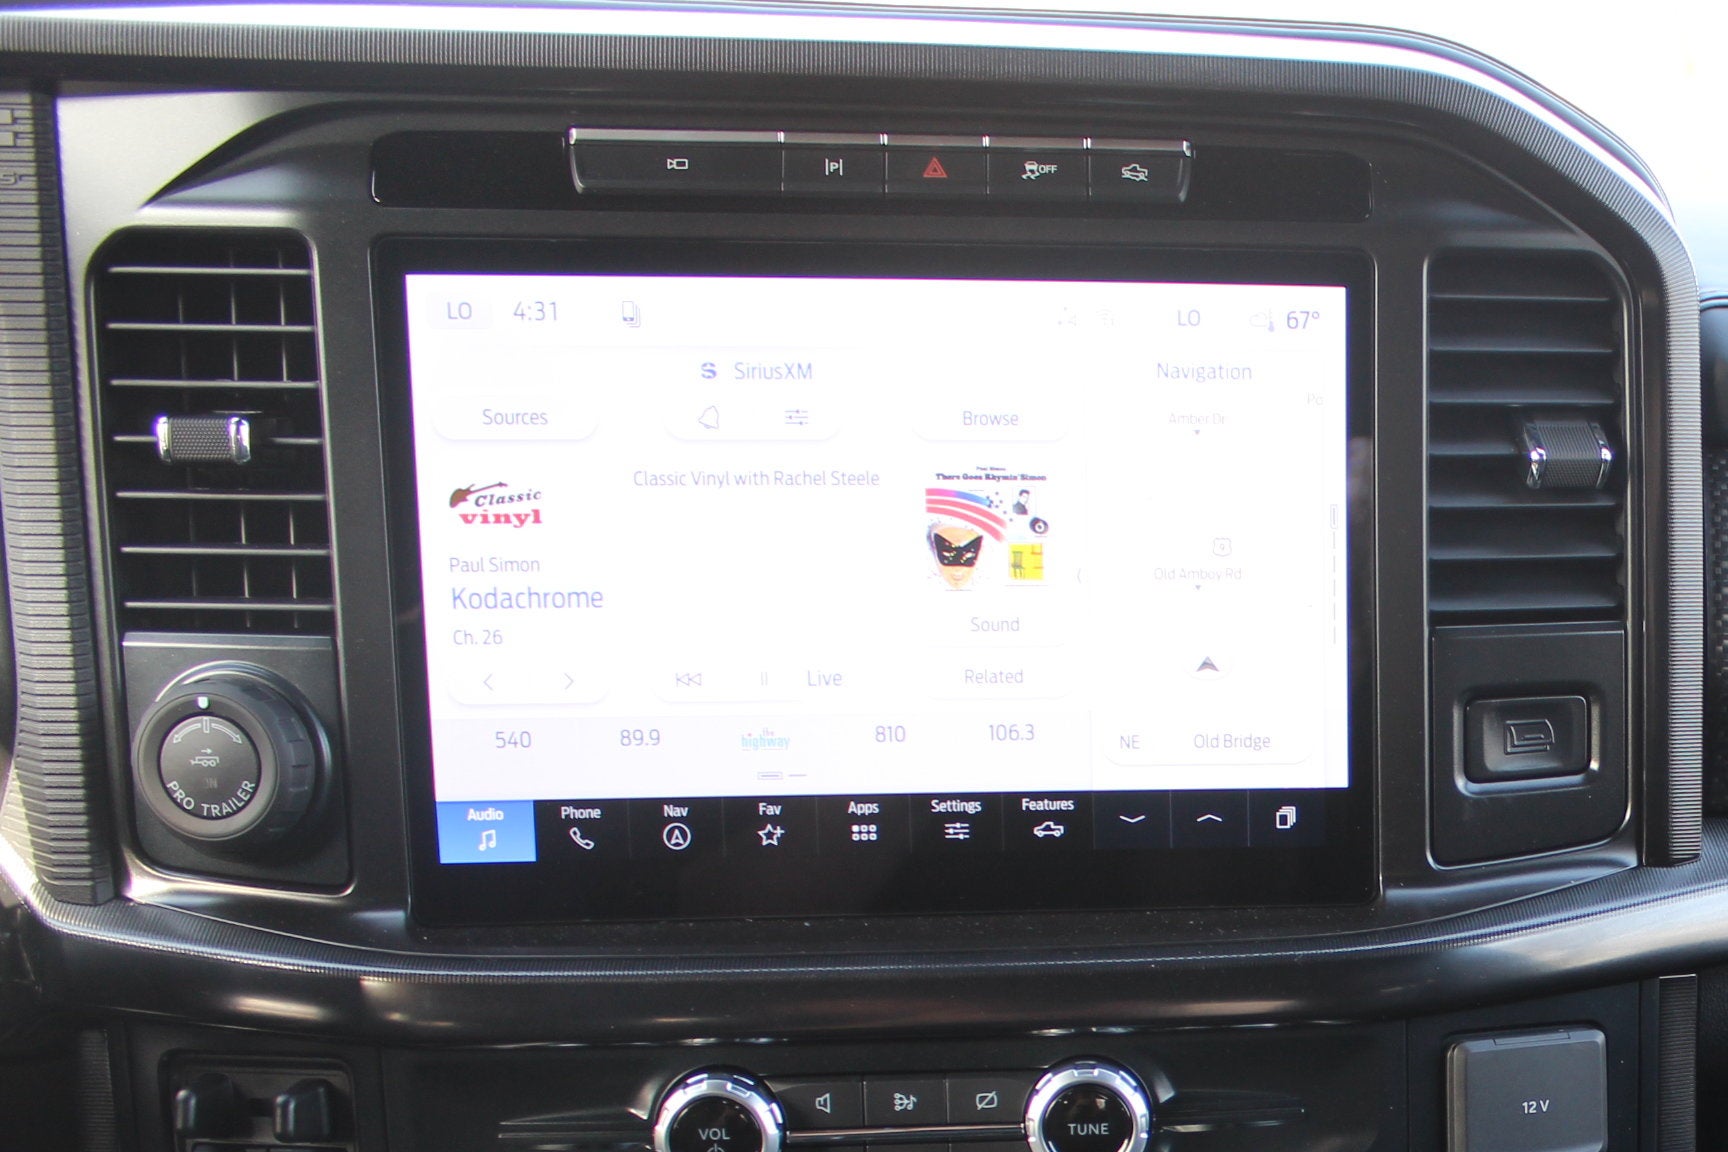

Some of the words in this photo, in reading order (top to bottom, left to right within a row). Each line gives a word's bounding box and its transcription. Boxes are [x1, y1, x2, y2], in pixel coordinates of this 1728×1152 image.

[1039, 163, 1058, 174] OFF
[447, 302, 473, 321] LO
[513, 301, 559, 321] 4:31
[1177, 310, 1201, 327] LO
[734, 362, 813, 381] SiriusXM
[1156, 363, 1252, 384] Navigation
[482, 408, 548, 426] Sources
[962, 411, 1019, 426] Browse
[1168, 412, 1209, 424] Amber
[633, 471, 686, 487] Classic
[691, 471, 730, 490] Vinyl
[734, 471, 769, 486] with
[774, 471, 826, 486] Rachel
[831, 471, 880, 486] Steele
[474, 488, 542, 507] Classic
[458, 509, 543, 528] vinyl
[449, 557, 484, 573] Paul
[488, 557, 540, 573] Simon
[451, 587, 604, 610] Kodachrome
[970, 616, 1020, 633] Sound
[453, 629, 478, 646] Ch.
[482, 629, 503, 646] 26
[807, 670, 843, 687] Live
[964, 669, 1024, 685] Related
[495, 731, 532, 749] 540
[619, 729, 661, 747] 89.9
[875, 726, 906, 744] 810
[988, 724, 1035, 742] 106.3
[741, 734, 790, 751] highway
[1120, 734, 1140, 750] NE
[1194, 733, 1221, 749] Old
[1223, 733, 1271, 752] Bridge
[167, 781, 195, 810] PRO
[201, 781, 256, 816] TRAILER
[931, 798, 982, 816] Settings
[1021, 798, 1074, 812] Features
[467, 807, 504, 822] Audio
[561, 805, 601, 820] Phone
[664, 804, 688, 818] Nav
[758, 802, 782, 816] Fav
[848, 801, 879, 817] Apps
[1522, 1101, 1537, 1114] 12
[1540, 1100, 1550, 1113] V
[699, 1128, 730, 1141] VOL
[1068, 1123, 1109, 1136] TUNE
